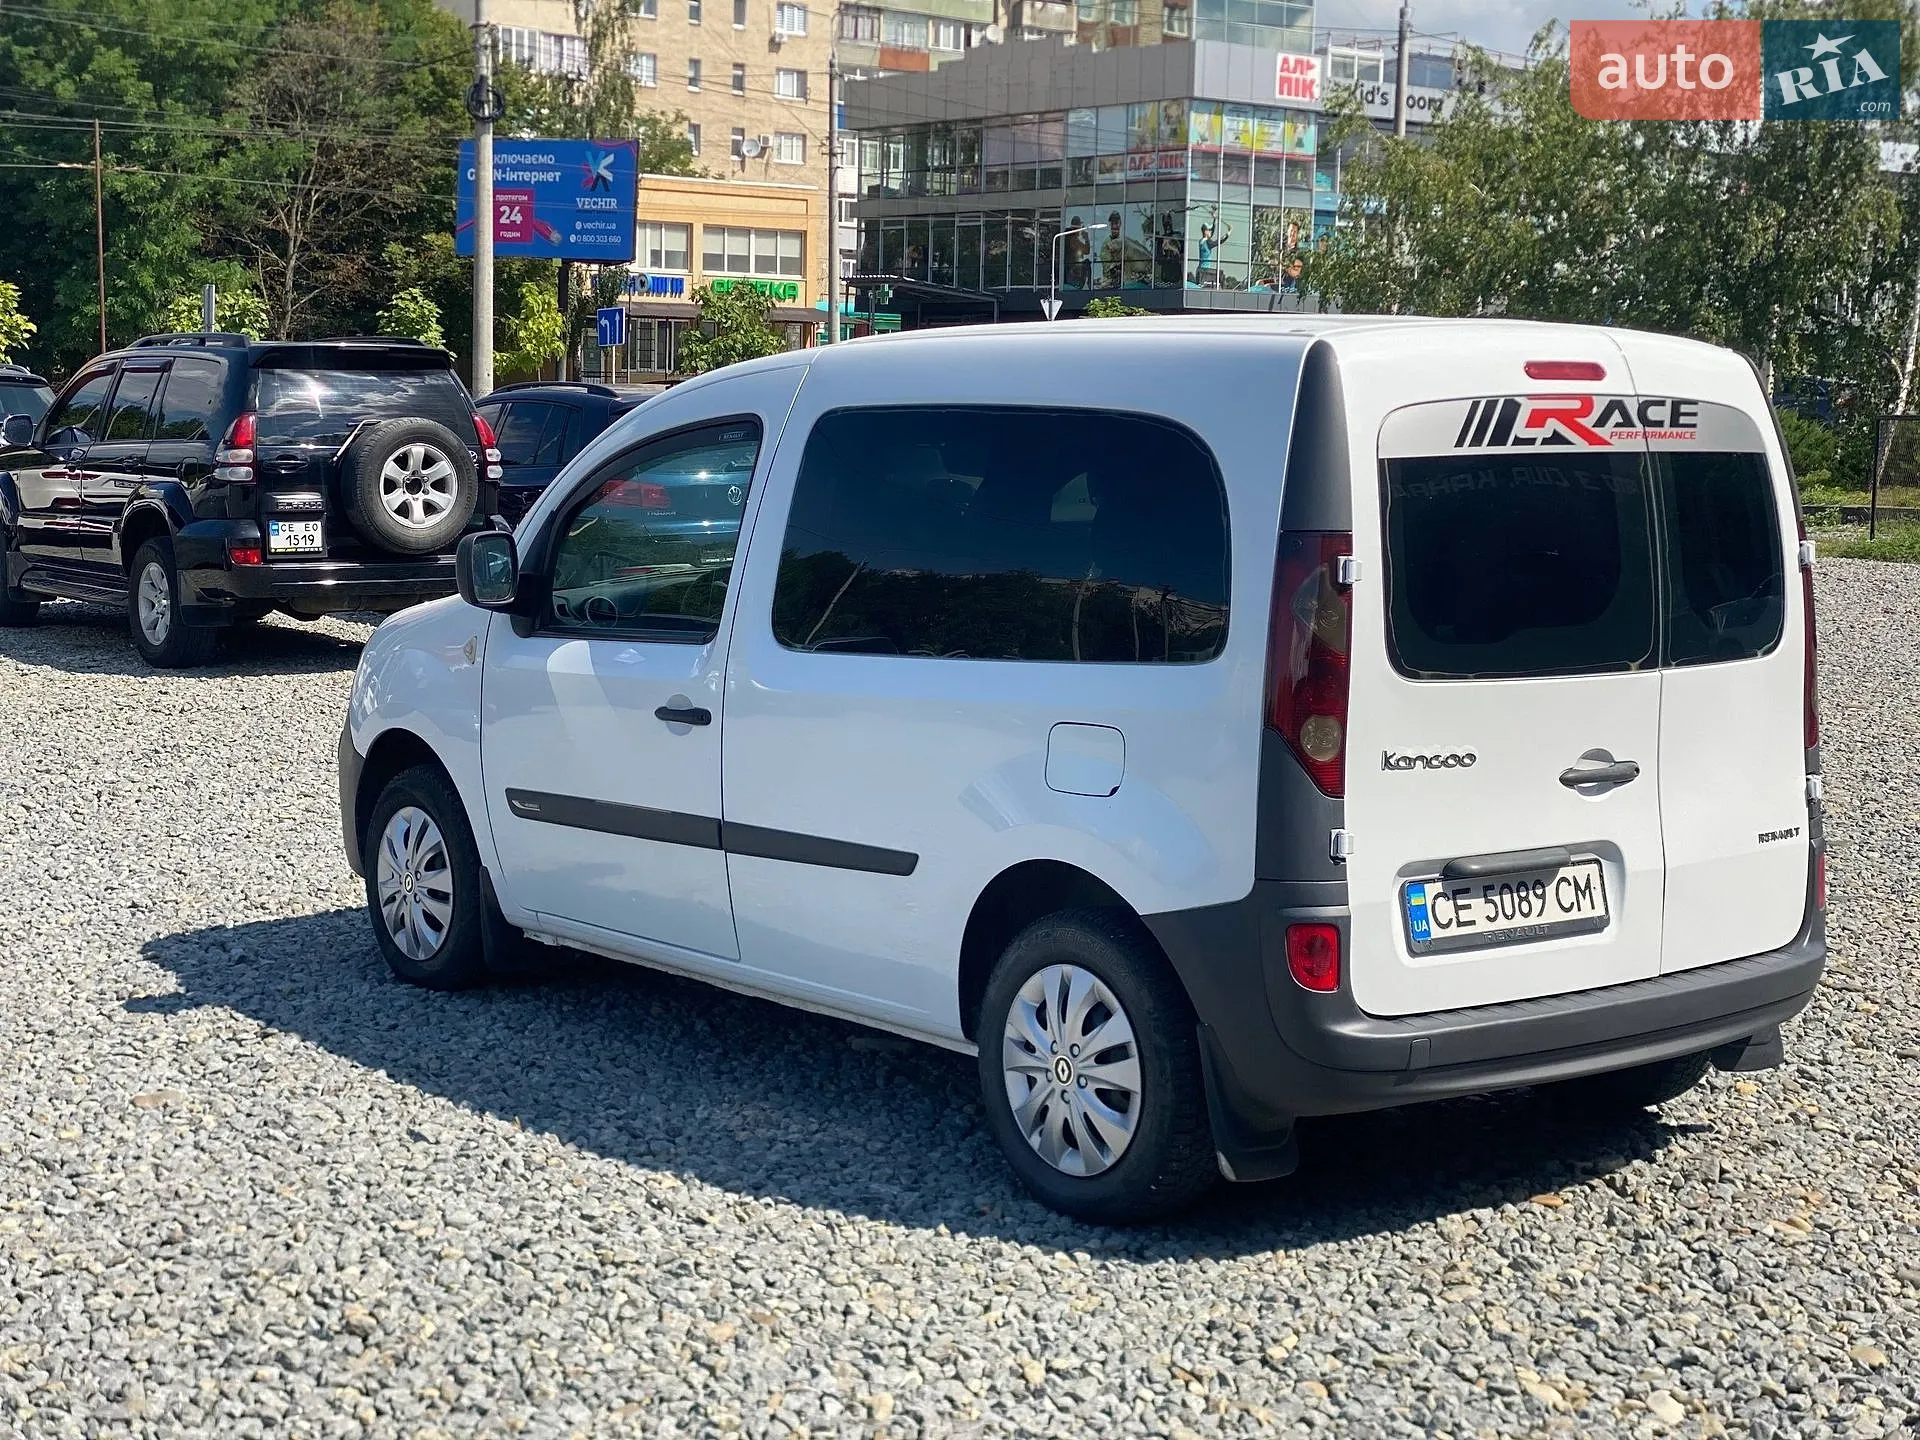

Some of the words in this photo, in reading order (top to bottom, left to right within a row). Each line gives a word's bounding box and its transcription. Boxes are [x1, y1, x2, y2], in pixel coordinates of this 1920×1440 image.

[467, 167, 561, 185] GN-інтернет
[575, 197, 618, 209] VECHIR
[499, 205, 523, 224] 24
[582, 220, 617, 230] vechir.ua
[1609, 430, 1698, 441] PERFORMANCE
[280, 523, 295, 533] CE
[286, 534, 315, 547] 1519
[1757, 827, 1801, 844] RENAULT
[1430, 886, 1477, 930] CE
[1481, 878, 1547, 923] 5089
[1555, 873, 1597, 914] CM
[1414, 919, 1429, 933] UA
[1482, 924, 1551, 943] RENAULT
